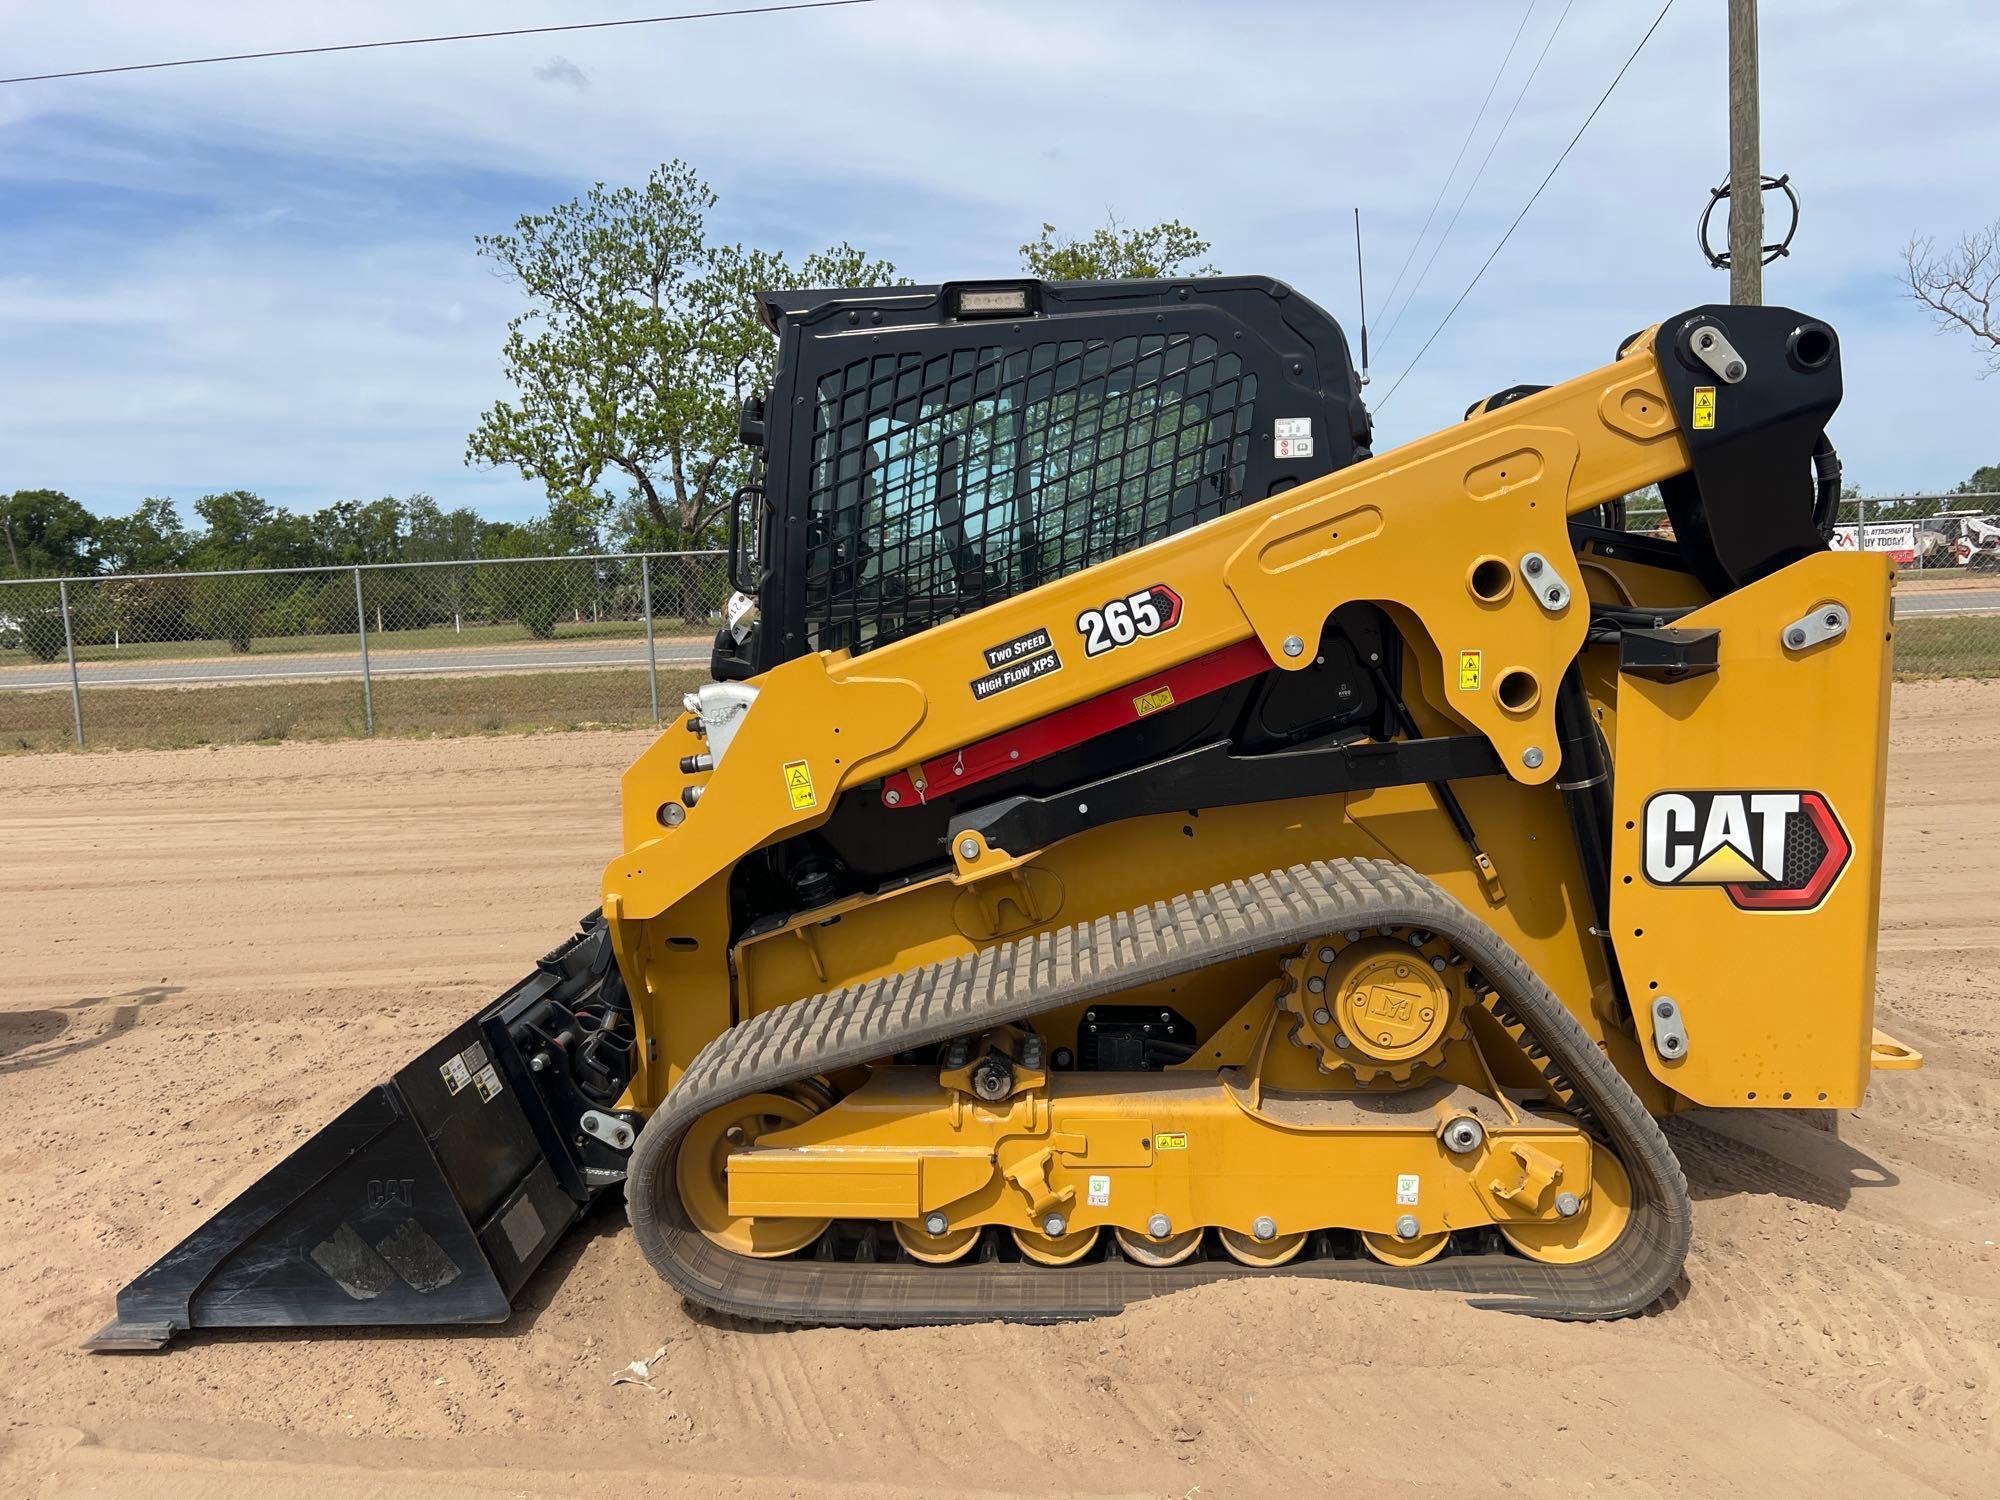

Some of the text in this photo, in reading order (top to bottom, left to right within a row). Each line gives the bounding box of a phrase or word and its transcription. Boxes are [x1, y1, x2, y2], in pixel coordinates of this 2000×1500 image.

[1872, 526, 1911, 536] ATTACHMENTS
[1878, 537, 1904, 547] TODAY!
[1078, 590, 1160, 655] 265
[989, 634, 1045, 665] TWO SPEED
[977, 655, 1054, 695] HIGH FLOW XPS
[1646, 793, 1800, 882] CAT
[367, 1179, 415, 1209] CAT
